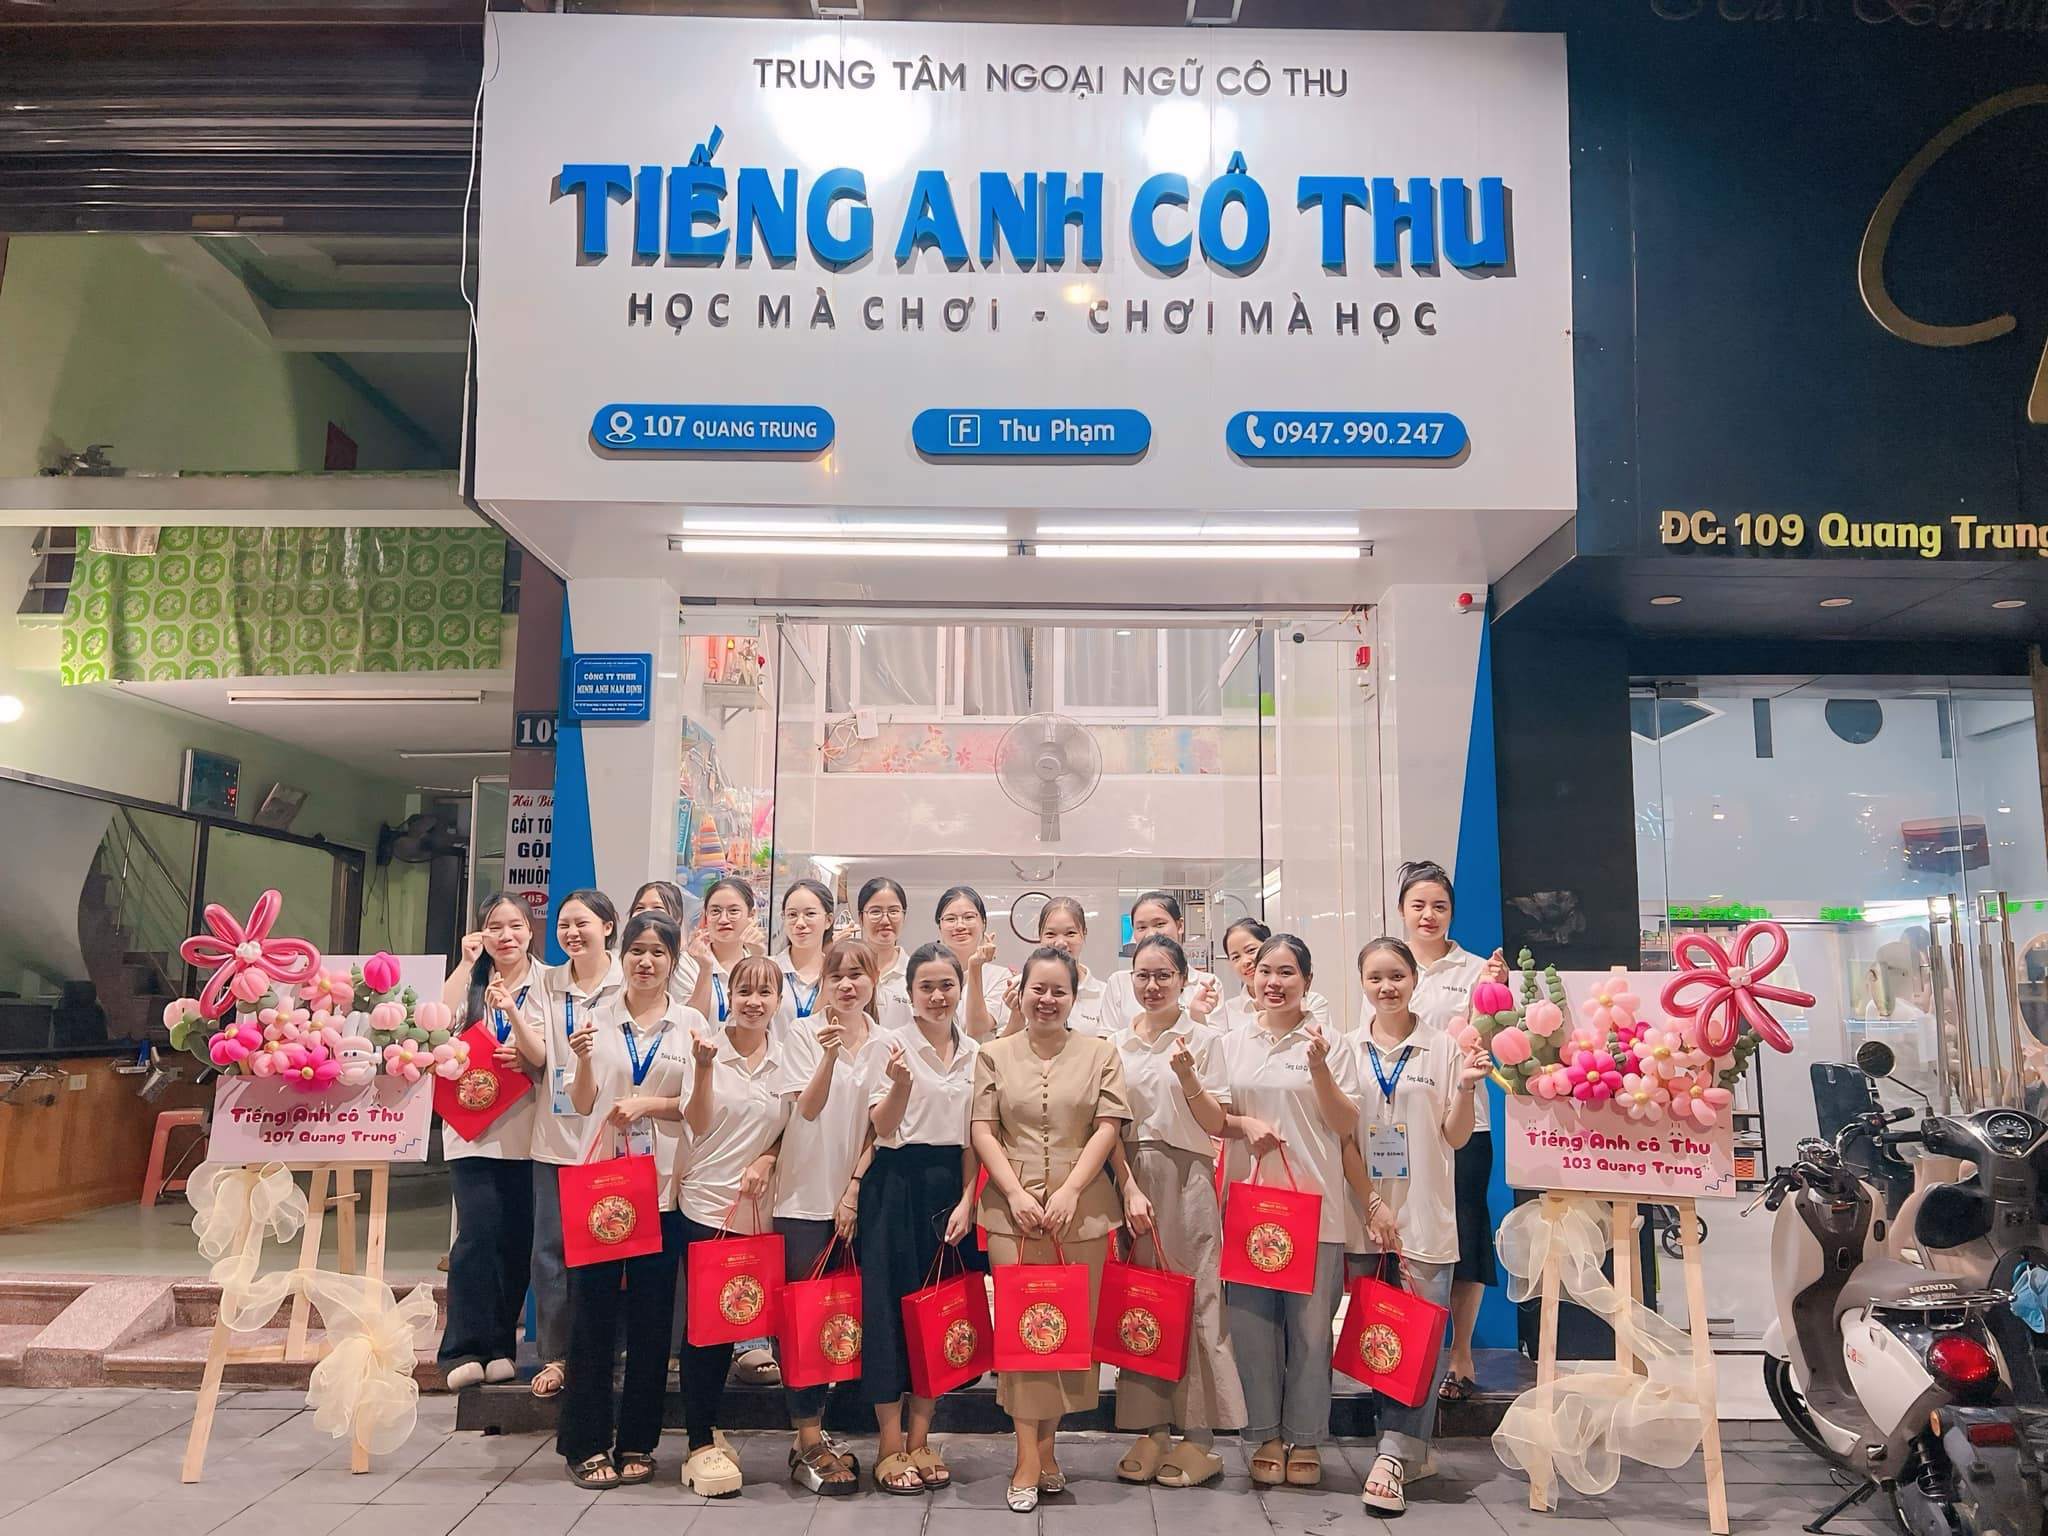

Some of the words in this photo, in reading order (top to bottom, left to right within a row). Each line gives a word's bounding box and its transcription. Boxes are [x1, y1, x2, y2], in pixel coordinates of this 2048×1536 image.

[753, 58, 876, 91] TRUNG
[892, 55, 966, 92] TÂM
[987, 62, 1104, 100] NGOẠI
[1122, 58, 1205, 96] NGỮ
[1216, 60, 1271, 97] CÔ
[1283, 68, 1348, 98] THU
[558, 124, 874, 266] TIẾNG
[894, 170, 1104, 272] ANH
[1130, 150, 1271, 270] CÔ
[1297, 175, 1509, 270] THU
[628, 292, 730, 335] HỌC
[758, 287, 836, 330] MÀ
[863, 296, 1001, 332] CHƠI
[1089, 298, 1214, 335] CHƠI
[1240, 292, 1314, 336] MÀ
[1335, 301, 1438, 344] HỌC
[644, 415, 686, 437] 107
[692, 420, 755, 440] QUANG
[759, 421, 817, 439] TRUNG
[999, 418, 1040, 442] Thu
[1051, 418, 1115, 446] Phạm
[1273, 421, 1444, 445] 0947.990.247
[1660, 510, 1727, 546] ĐC:
[1734, 512, 1806, 547] 109
[1818, 512, 1943, 558] Quang
[511, 812, 534, 834] CẮT
[537, 814, 552, 834] TÓ
[230, 1106, 288, 1126] Tiếng
[293, 1105, 331, 1123] Anh
[337, 1109, 359, 1123] cô
[367, 1107, 405, 1123] Thu
[263, 1131, 294, 1143] 107
[299, 1131, 346, 1145] Quang
[351, 1131, 397, 1145] Trung
[1526, 1129, 1584, 1151] Tiếng
[1590, 1132, 1631, 1151] Anh
[1636, 1137, 1661, 1153] cô
[1667, 1137, 1711, 1155] Thu
[1562, 1156, 1592, 1170] 103
[1597, 1159, 1647, 1176] Quang
[1652, 1161, 1703, 1179] Trung
[1908, 1283, 1959, 1294] HONDA
